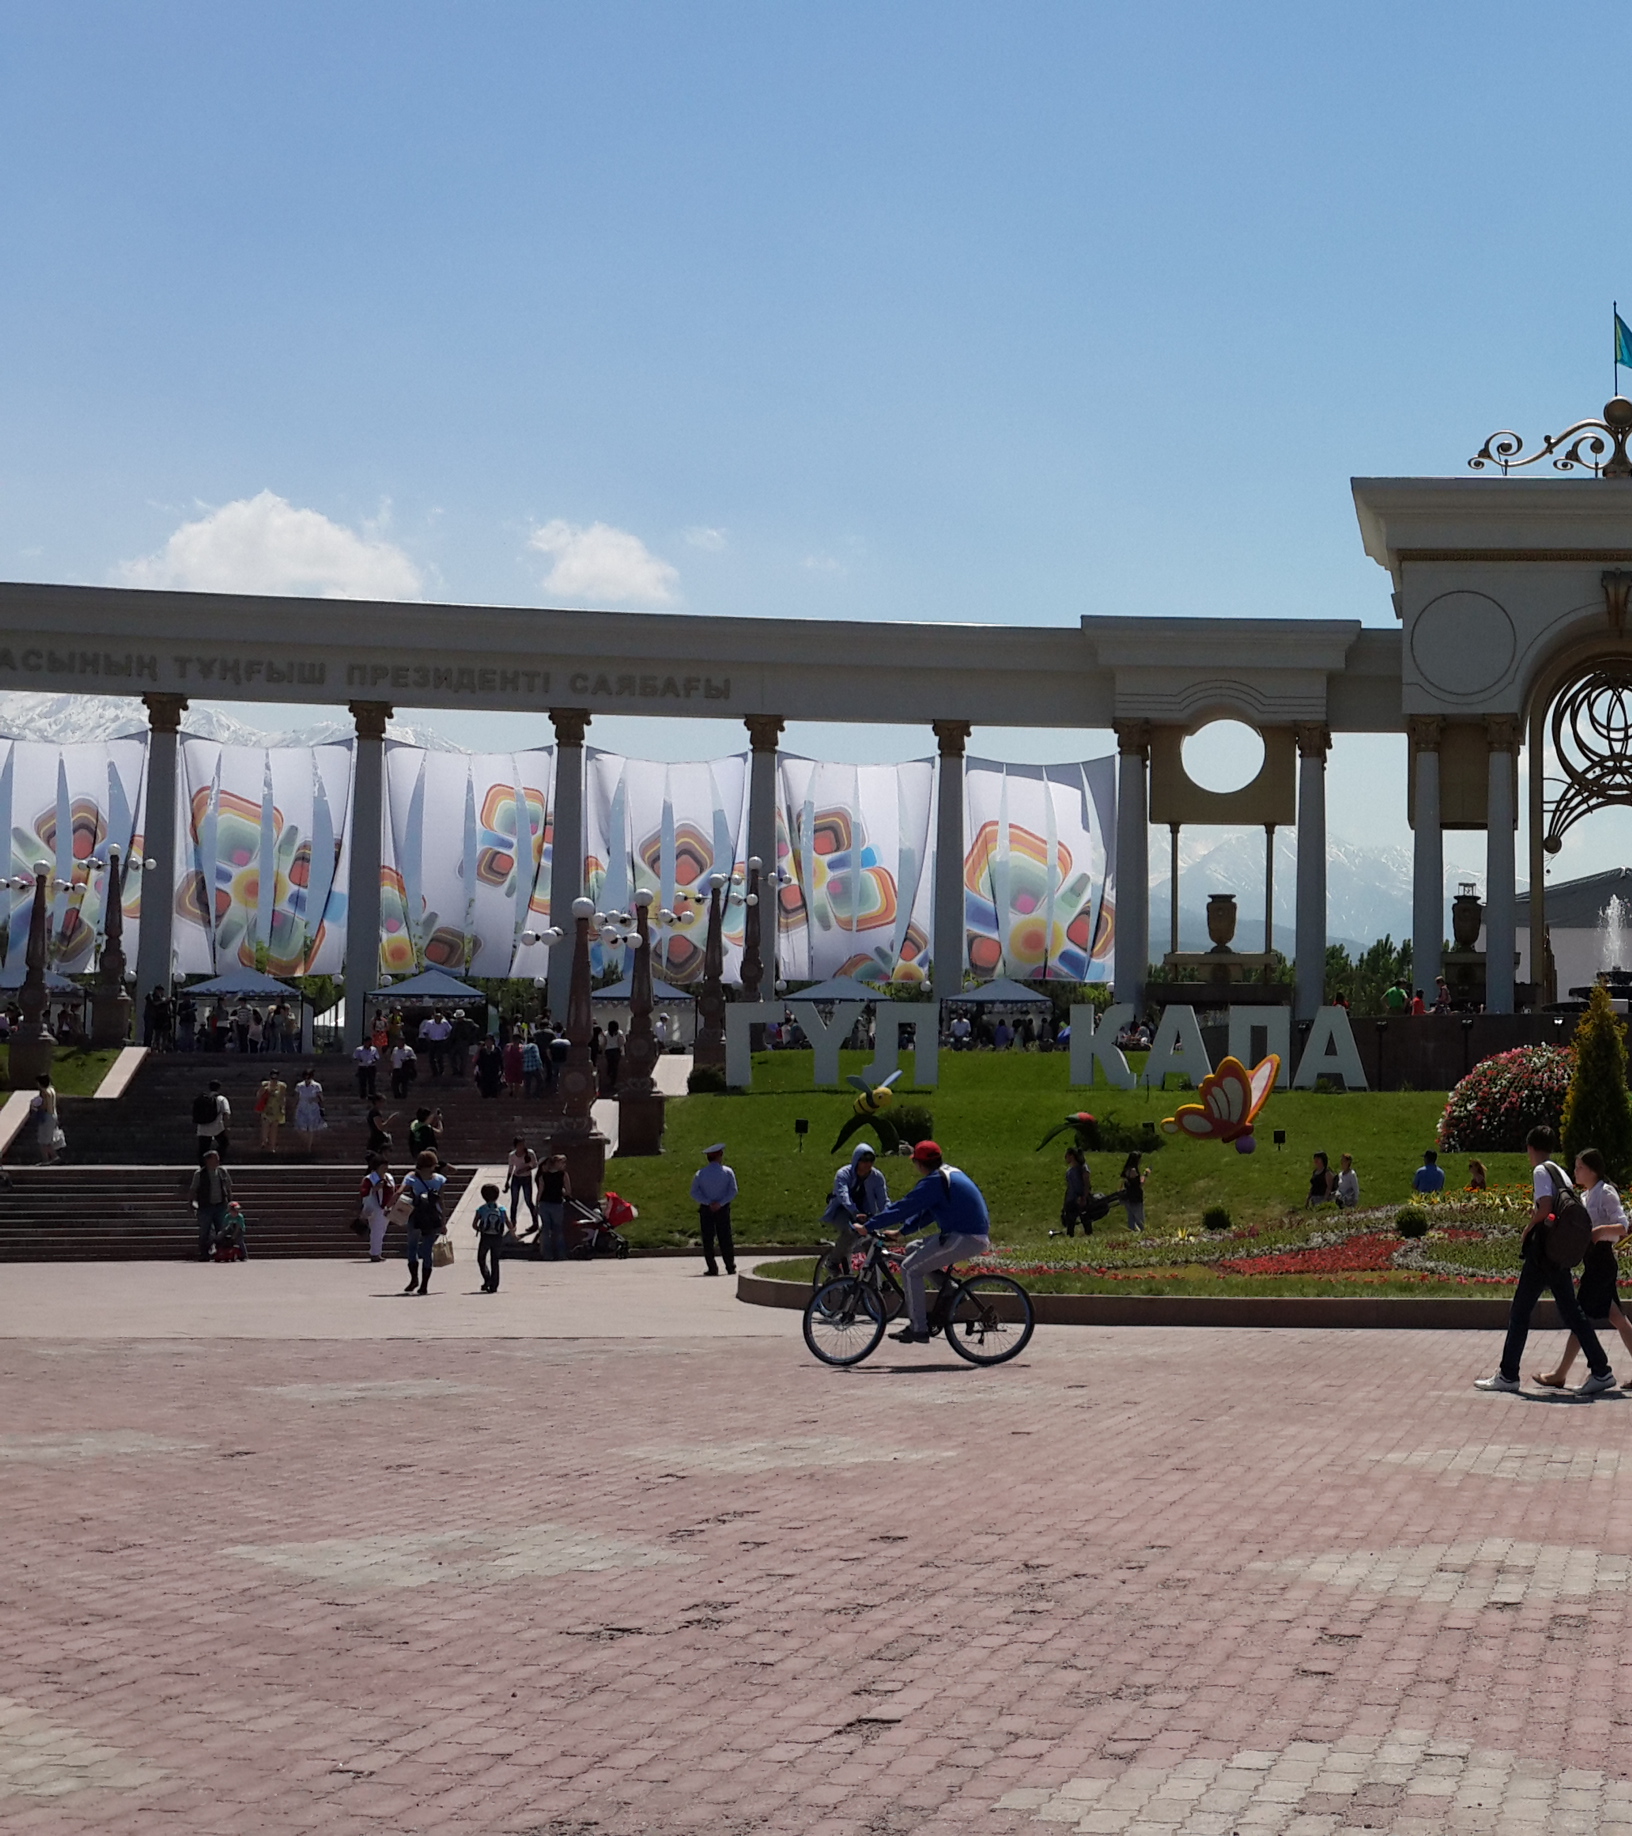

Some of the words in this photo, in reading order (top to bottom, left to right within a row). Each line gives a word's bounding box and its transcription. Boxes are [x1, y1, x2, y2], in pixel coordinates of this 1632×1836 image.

[173, 655, 326, 685] ТҰҢҒЫШ
[345, 663, 550, 694] ПРЕЗИДЕНТІ
[568, 672, 731, 700] САЯБАҒЫ
